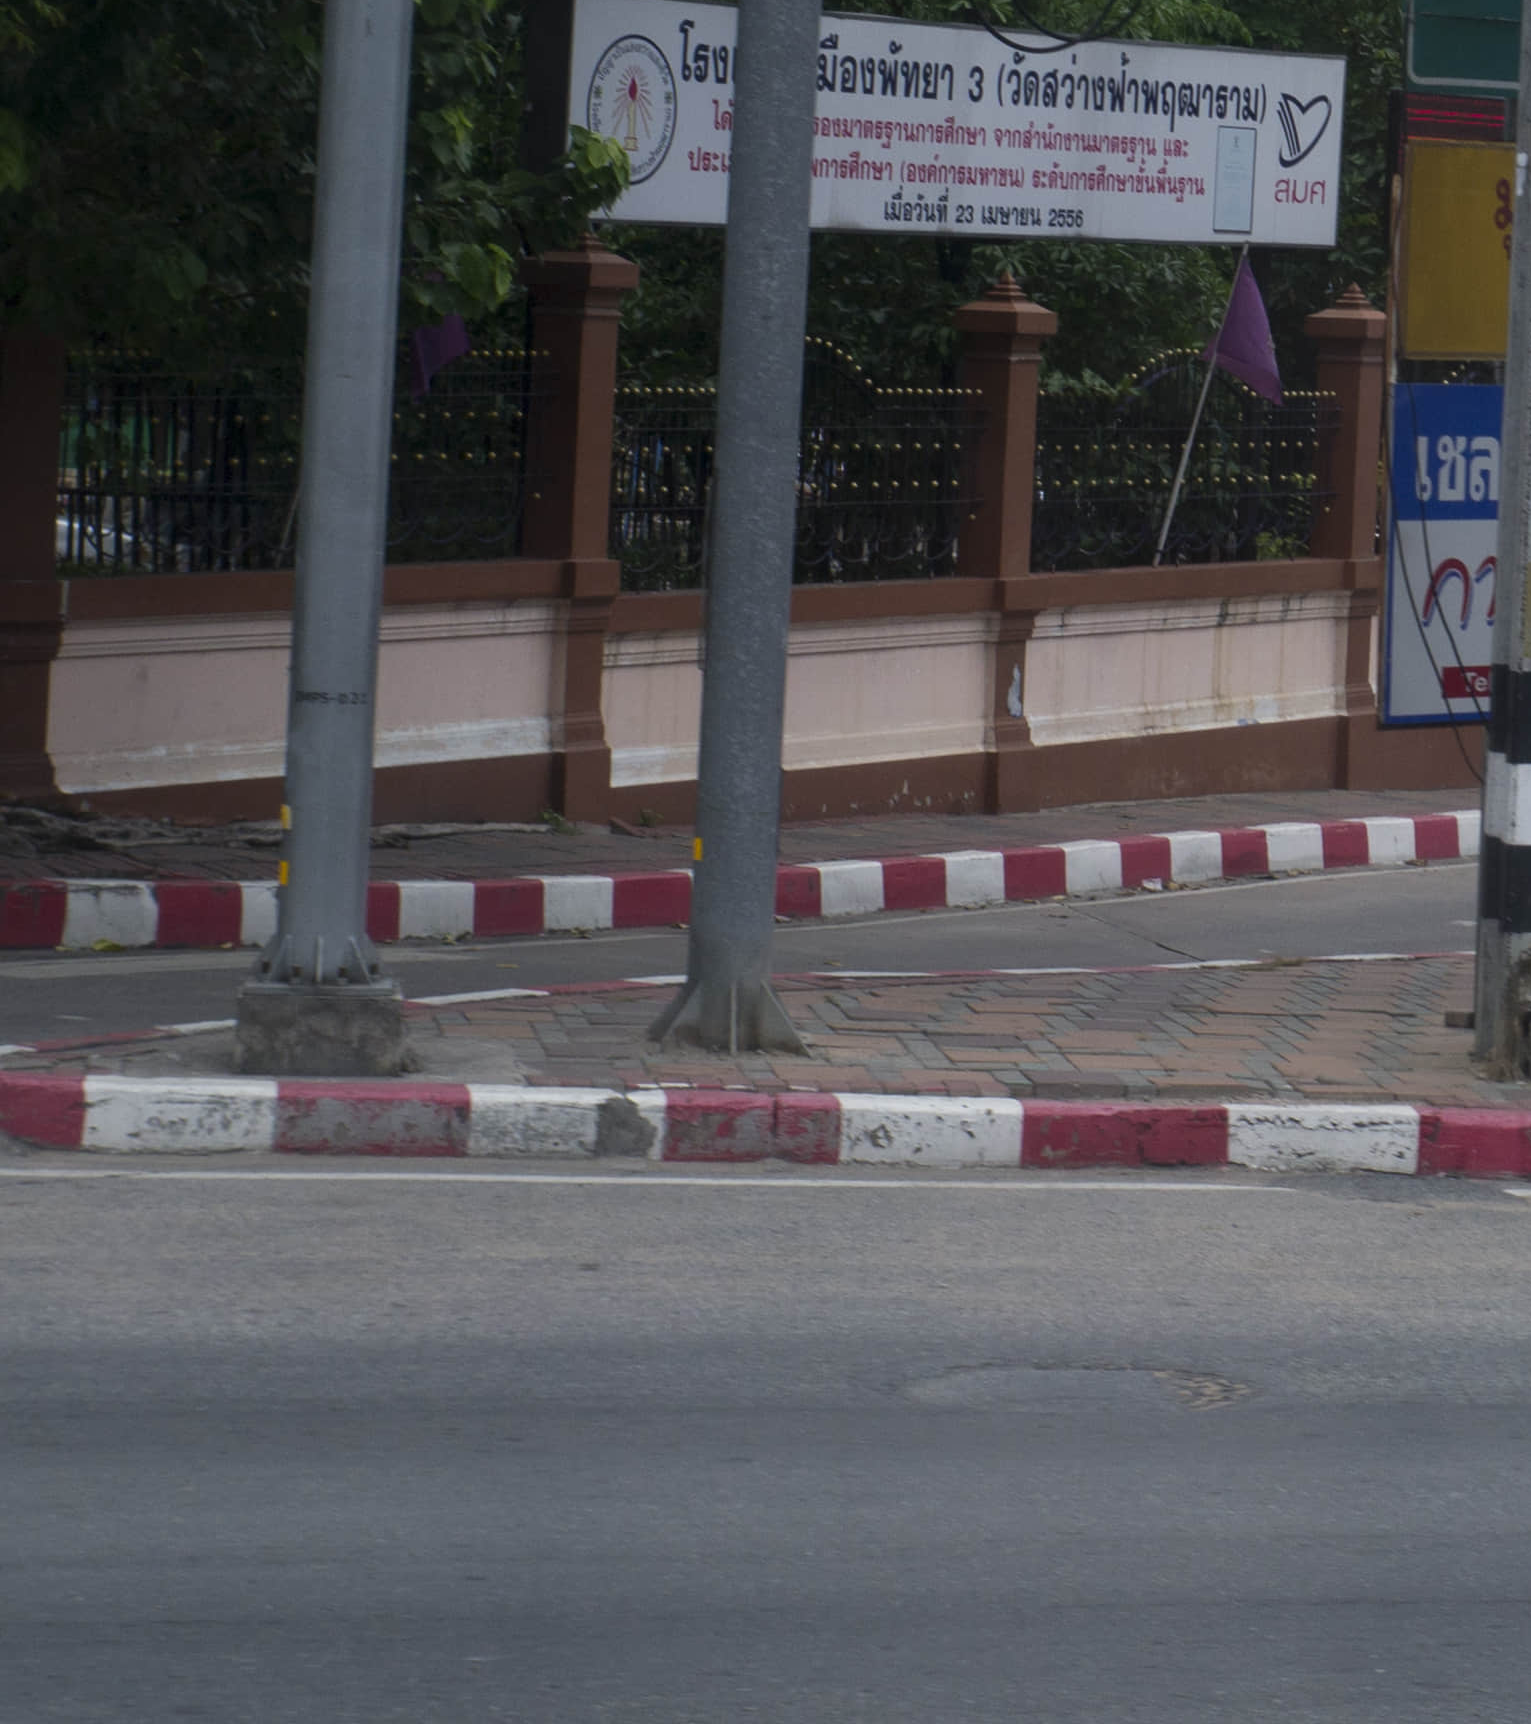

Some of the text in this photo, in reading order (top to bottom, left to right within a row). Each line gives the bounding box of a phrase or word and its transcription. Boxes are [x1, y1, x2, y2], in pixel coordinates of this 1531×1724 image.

[968, 65, 985, 103] 3
[954, 203, 974, 224] 23
[981, 205, 1042, 228] เมษายน
[1047, 207, 1085, 228] 2556
